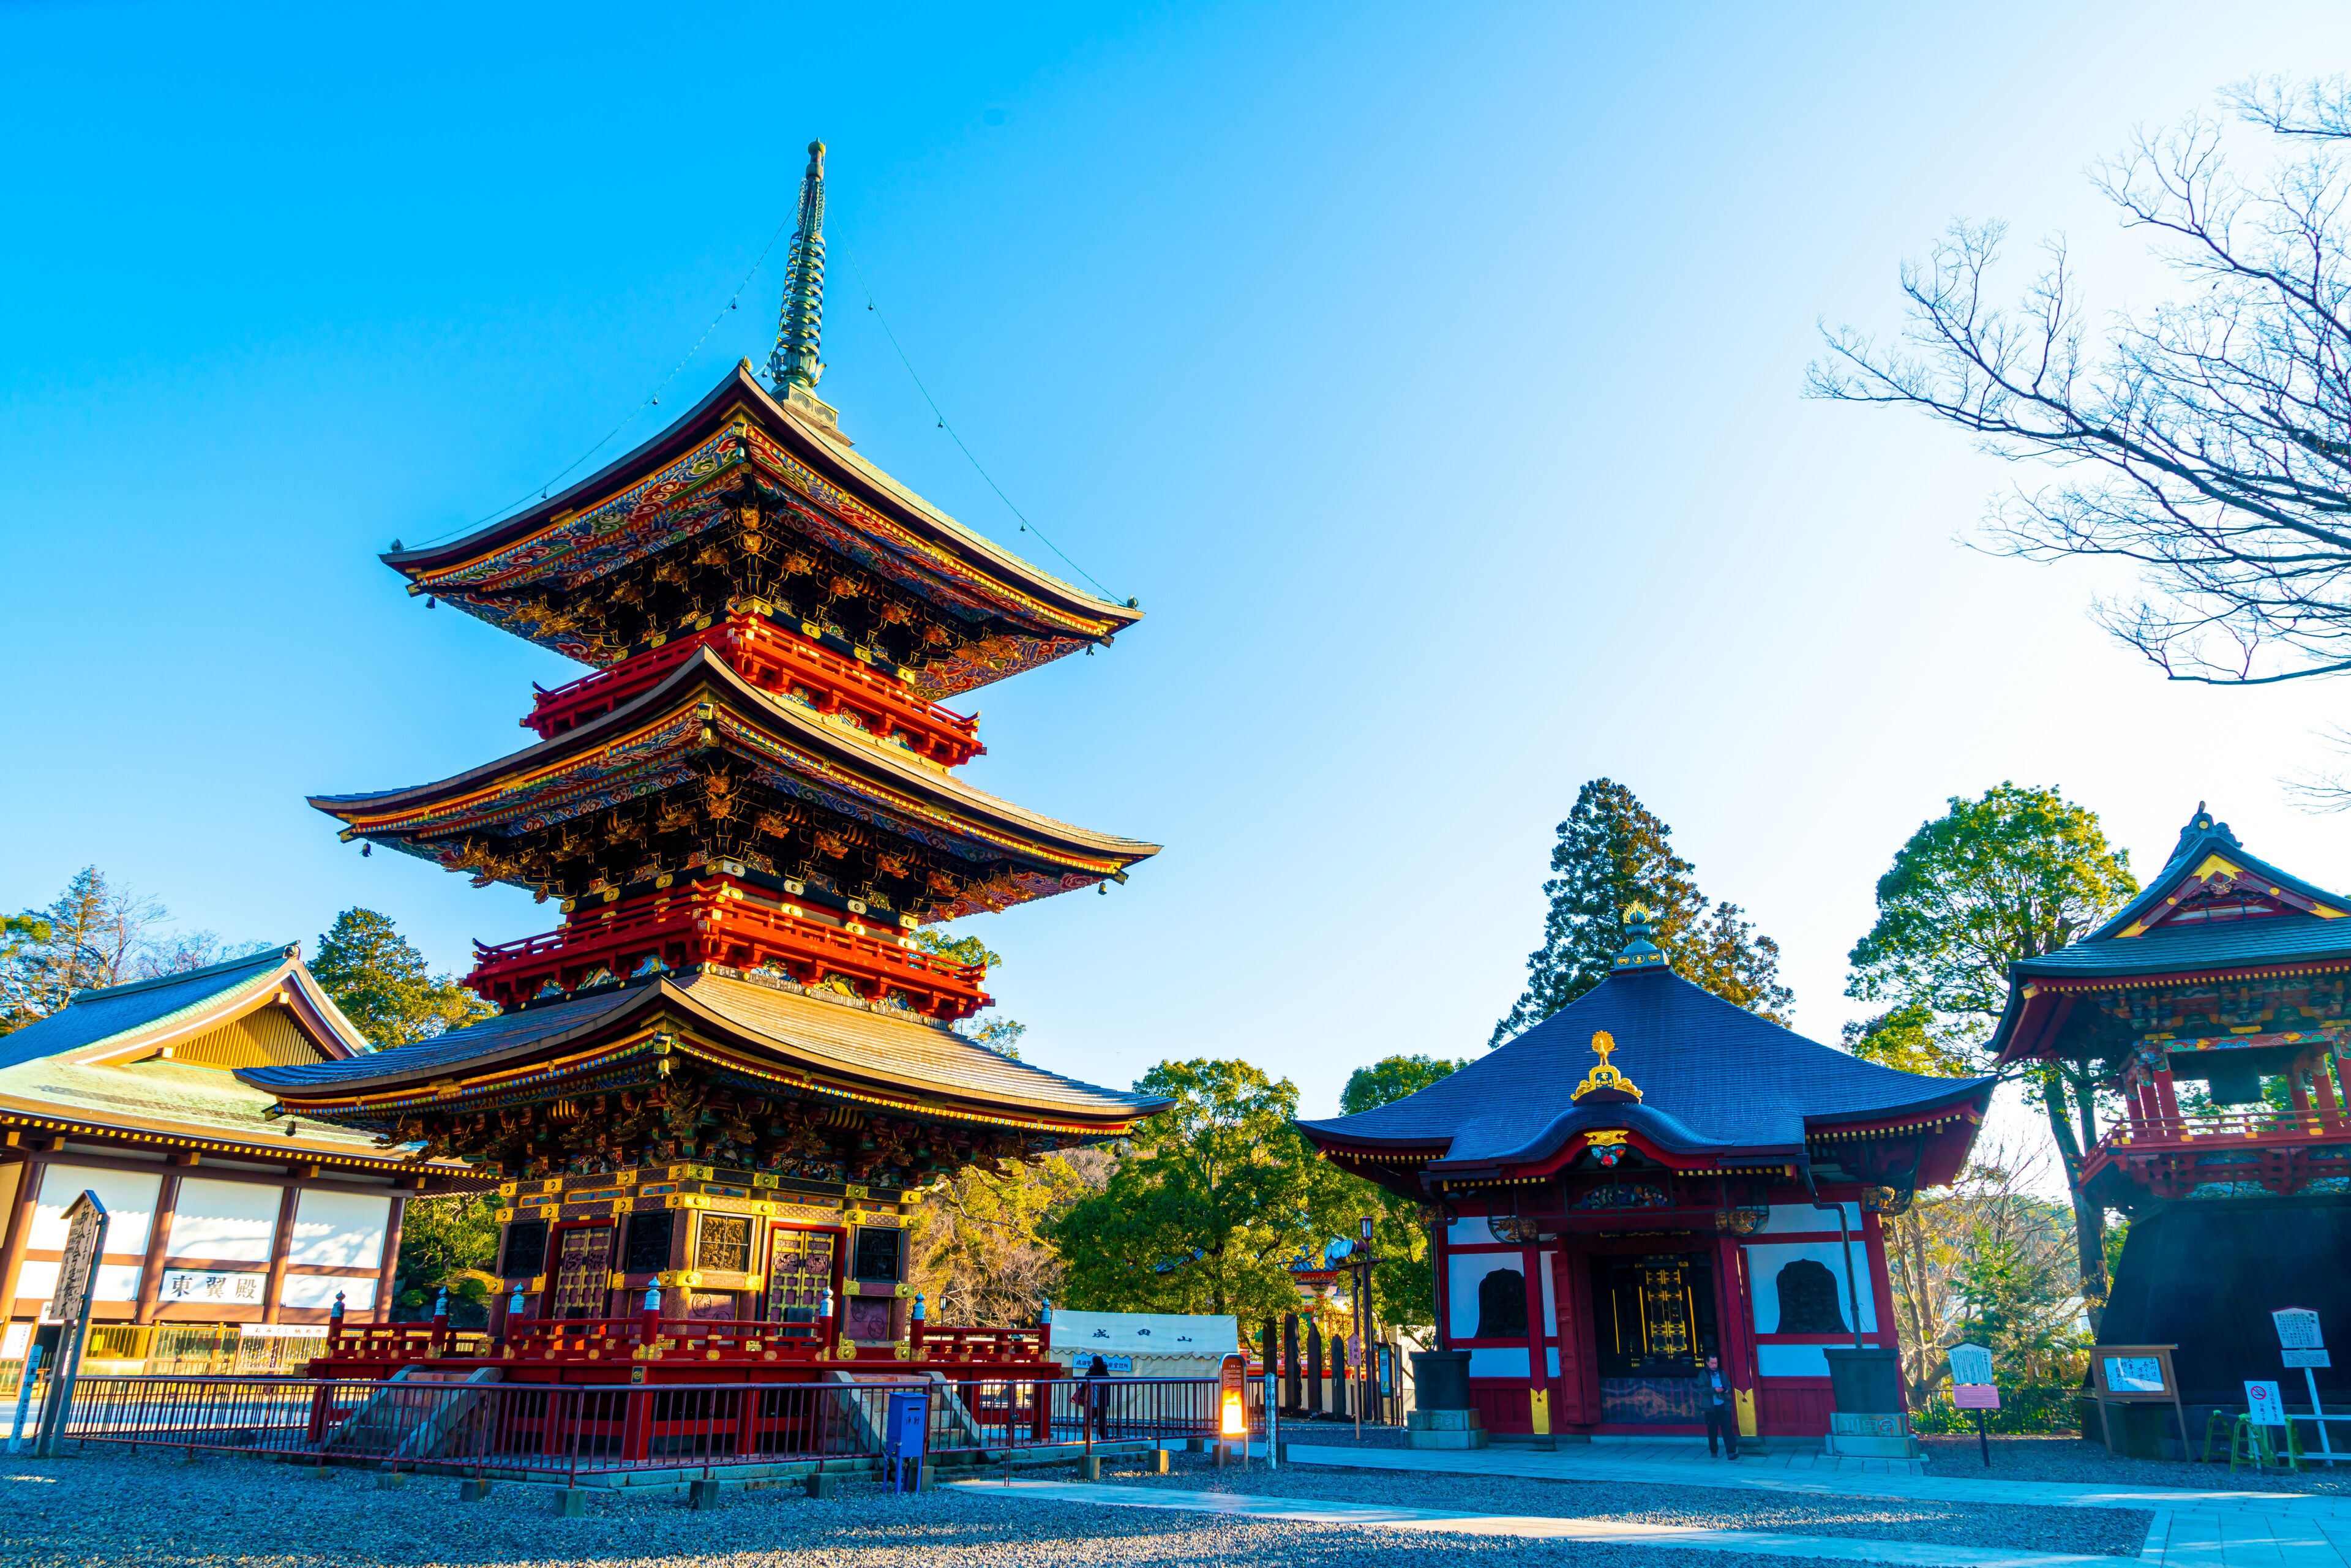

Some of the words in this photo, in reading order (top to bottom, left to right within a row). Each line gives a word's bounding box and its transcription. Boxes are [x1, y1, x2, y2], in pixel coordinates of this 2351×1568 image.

[171, 1275, 257, 1299] 東翼殿
[1092, 1329, 1193, 1343] 成田山
[26, 1356, 39, 1389] 三重塔
